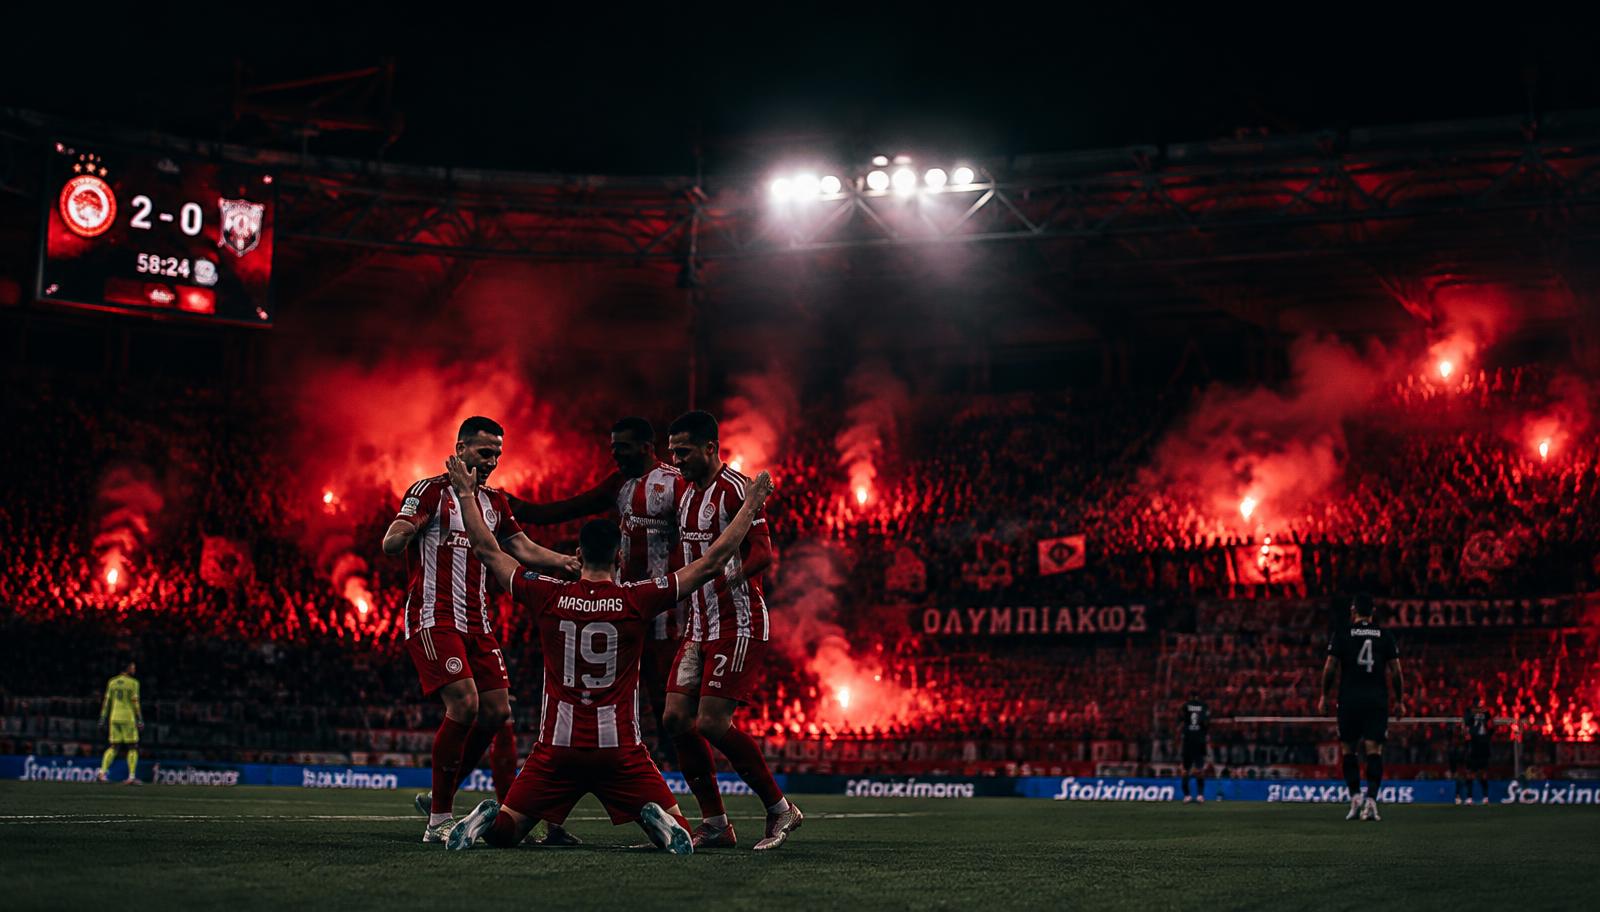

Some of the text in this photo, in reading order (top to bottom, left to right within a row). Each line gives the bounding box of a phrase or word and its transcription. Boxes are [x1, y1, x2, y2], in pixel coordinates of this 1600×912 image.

[136, 252, 191, 279] 58:24
[557, 596, 623, 612] MASOURAS
[558, 619, 618, 689] 19
[712, 653, 728, 677] 2
[1356, 639, 1375, 673] 4
[1053, 776, 1176, 801] Stoiximan
